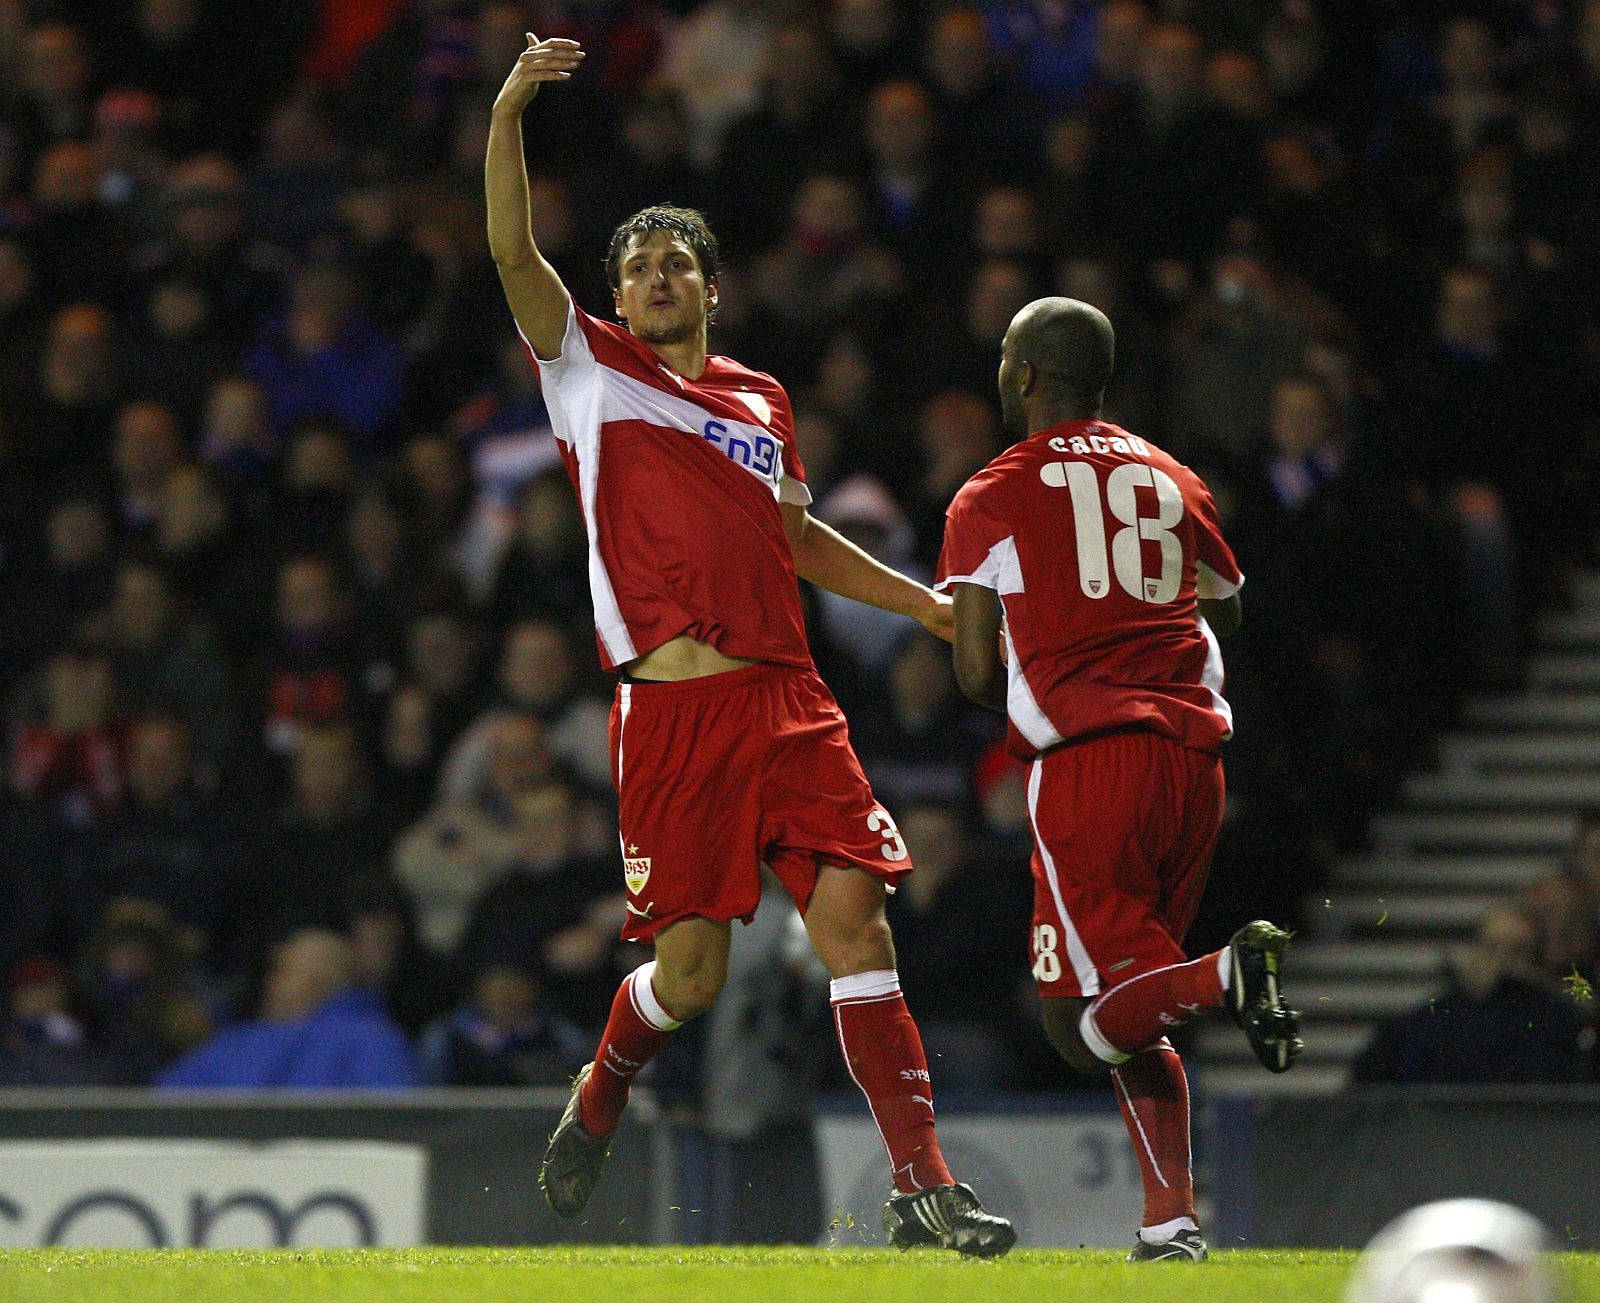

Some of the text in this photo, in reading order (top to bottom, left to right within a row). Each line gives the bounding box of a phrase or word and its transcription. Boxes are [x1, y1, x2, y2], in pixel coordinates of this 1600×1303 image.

[703, 420, 778, 484] EnB
[1040, 461, 1184, 604] 18
[867, 810, 907, 861] 3
